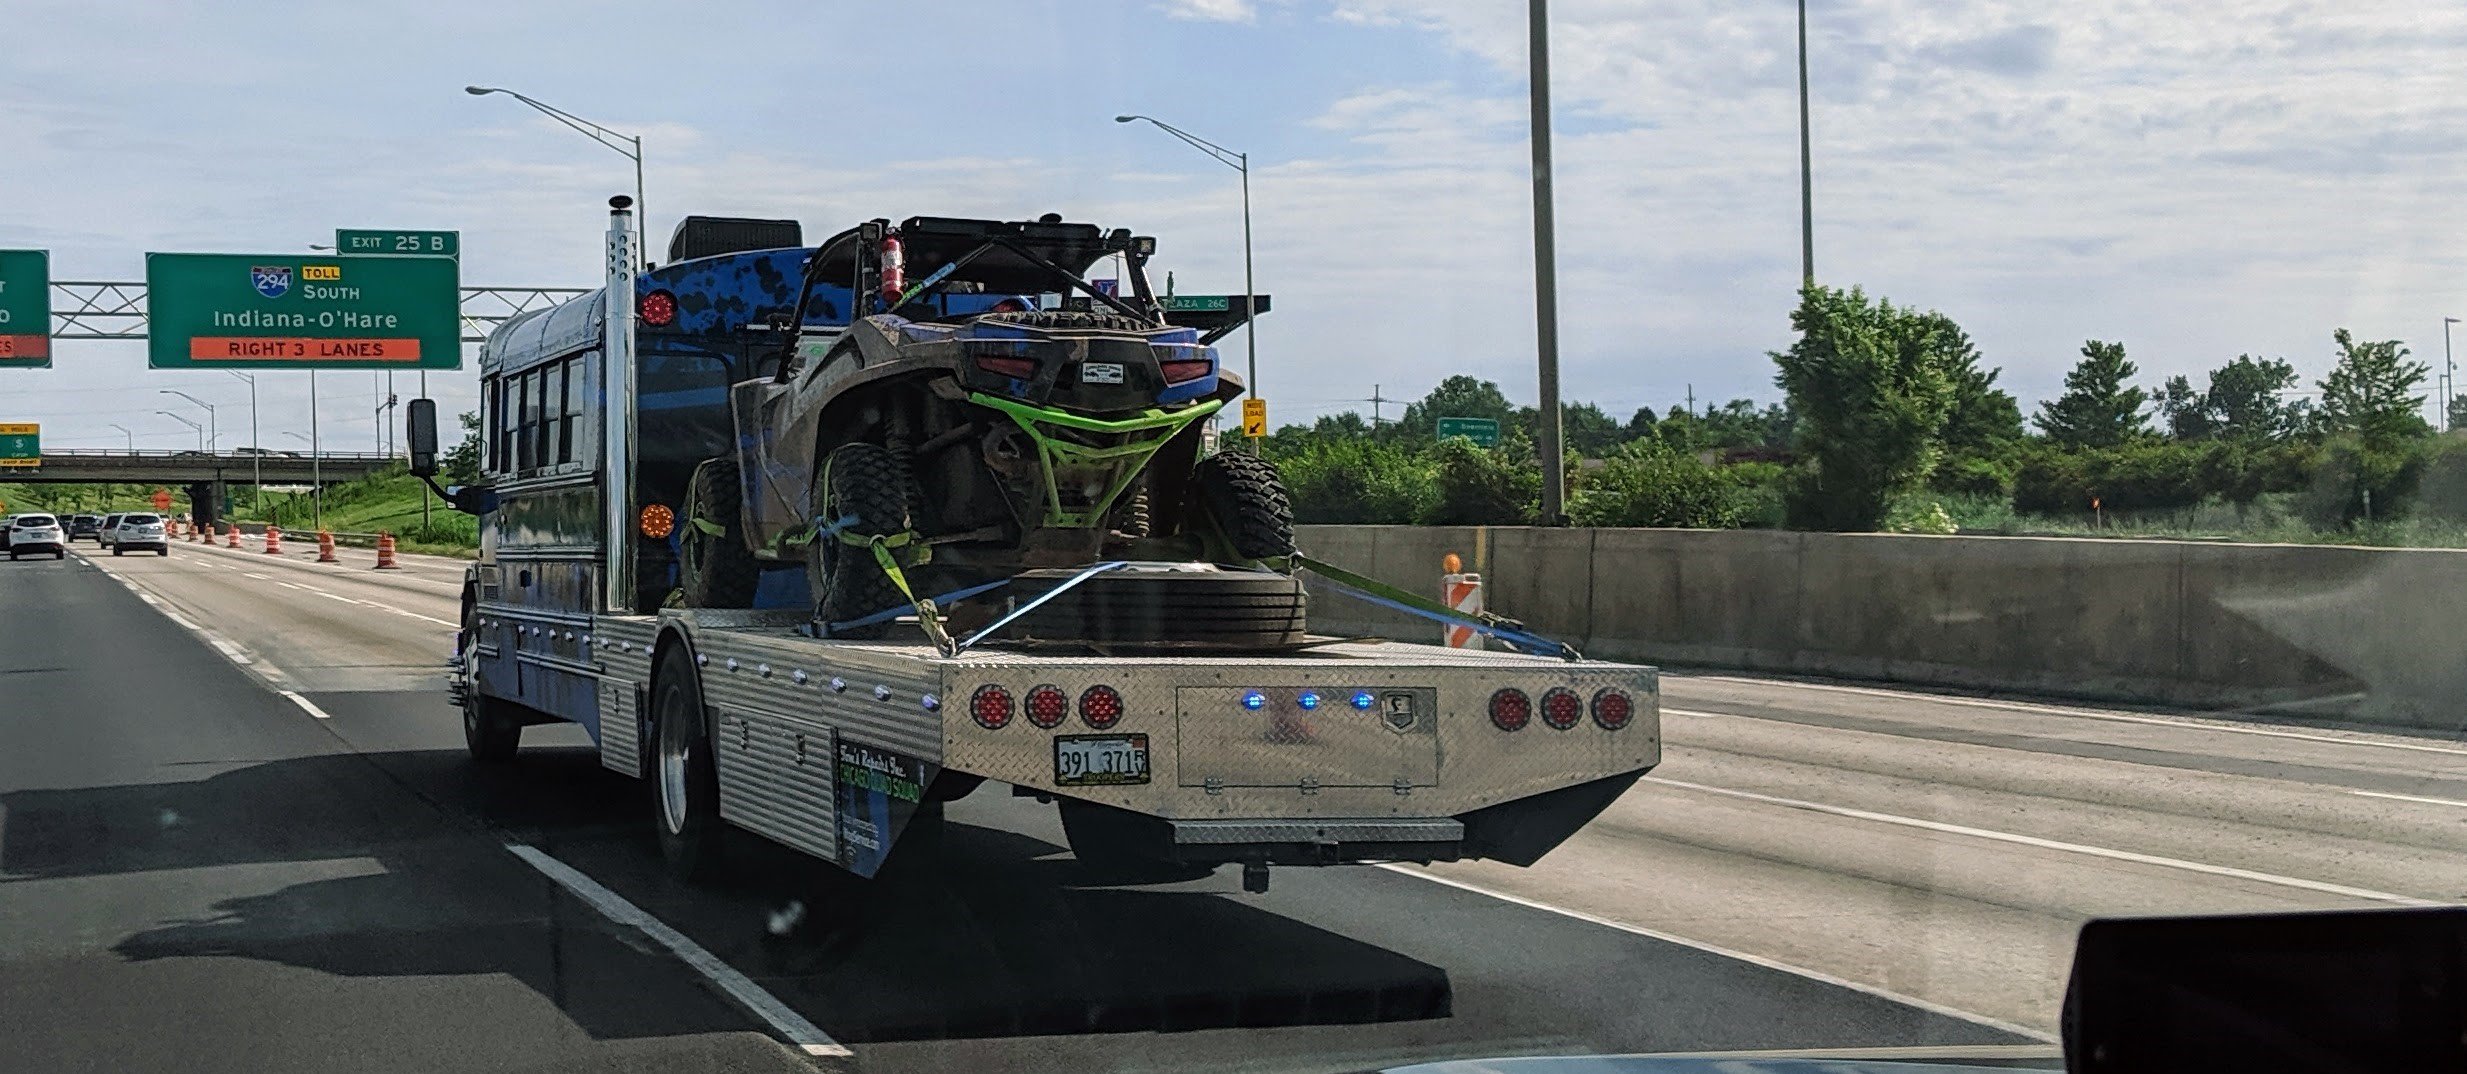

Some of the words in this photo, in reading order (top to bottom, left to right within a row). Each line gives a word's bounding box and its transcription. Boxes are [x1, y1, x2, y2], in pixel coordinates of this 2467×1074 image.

[352, 236, 382, 248] EXIT
[395, 235, 421, 251] 25
[431, 235, 444, 251] B
[257, 273, 289, 290] 294
[304, 268, 340, 279] TOLL
[213, 310, 398, 328] Indiana-O'Hare
[228, 342, 287, 357] RIGHT
[294, 343, 304, 357] 3
[320, 342, 385, 357] LANES
[1060, 750, 1090, 776] 391
[1102, 750, 1133, 775] 371
